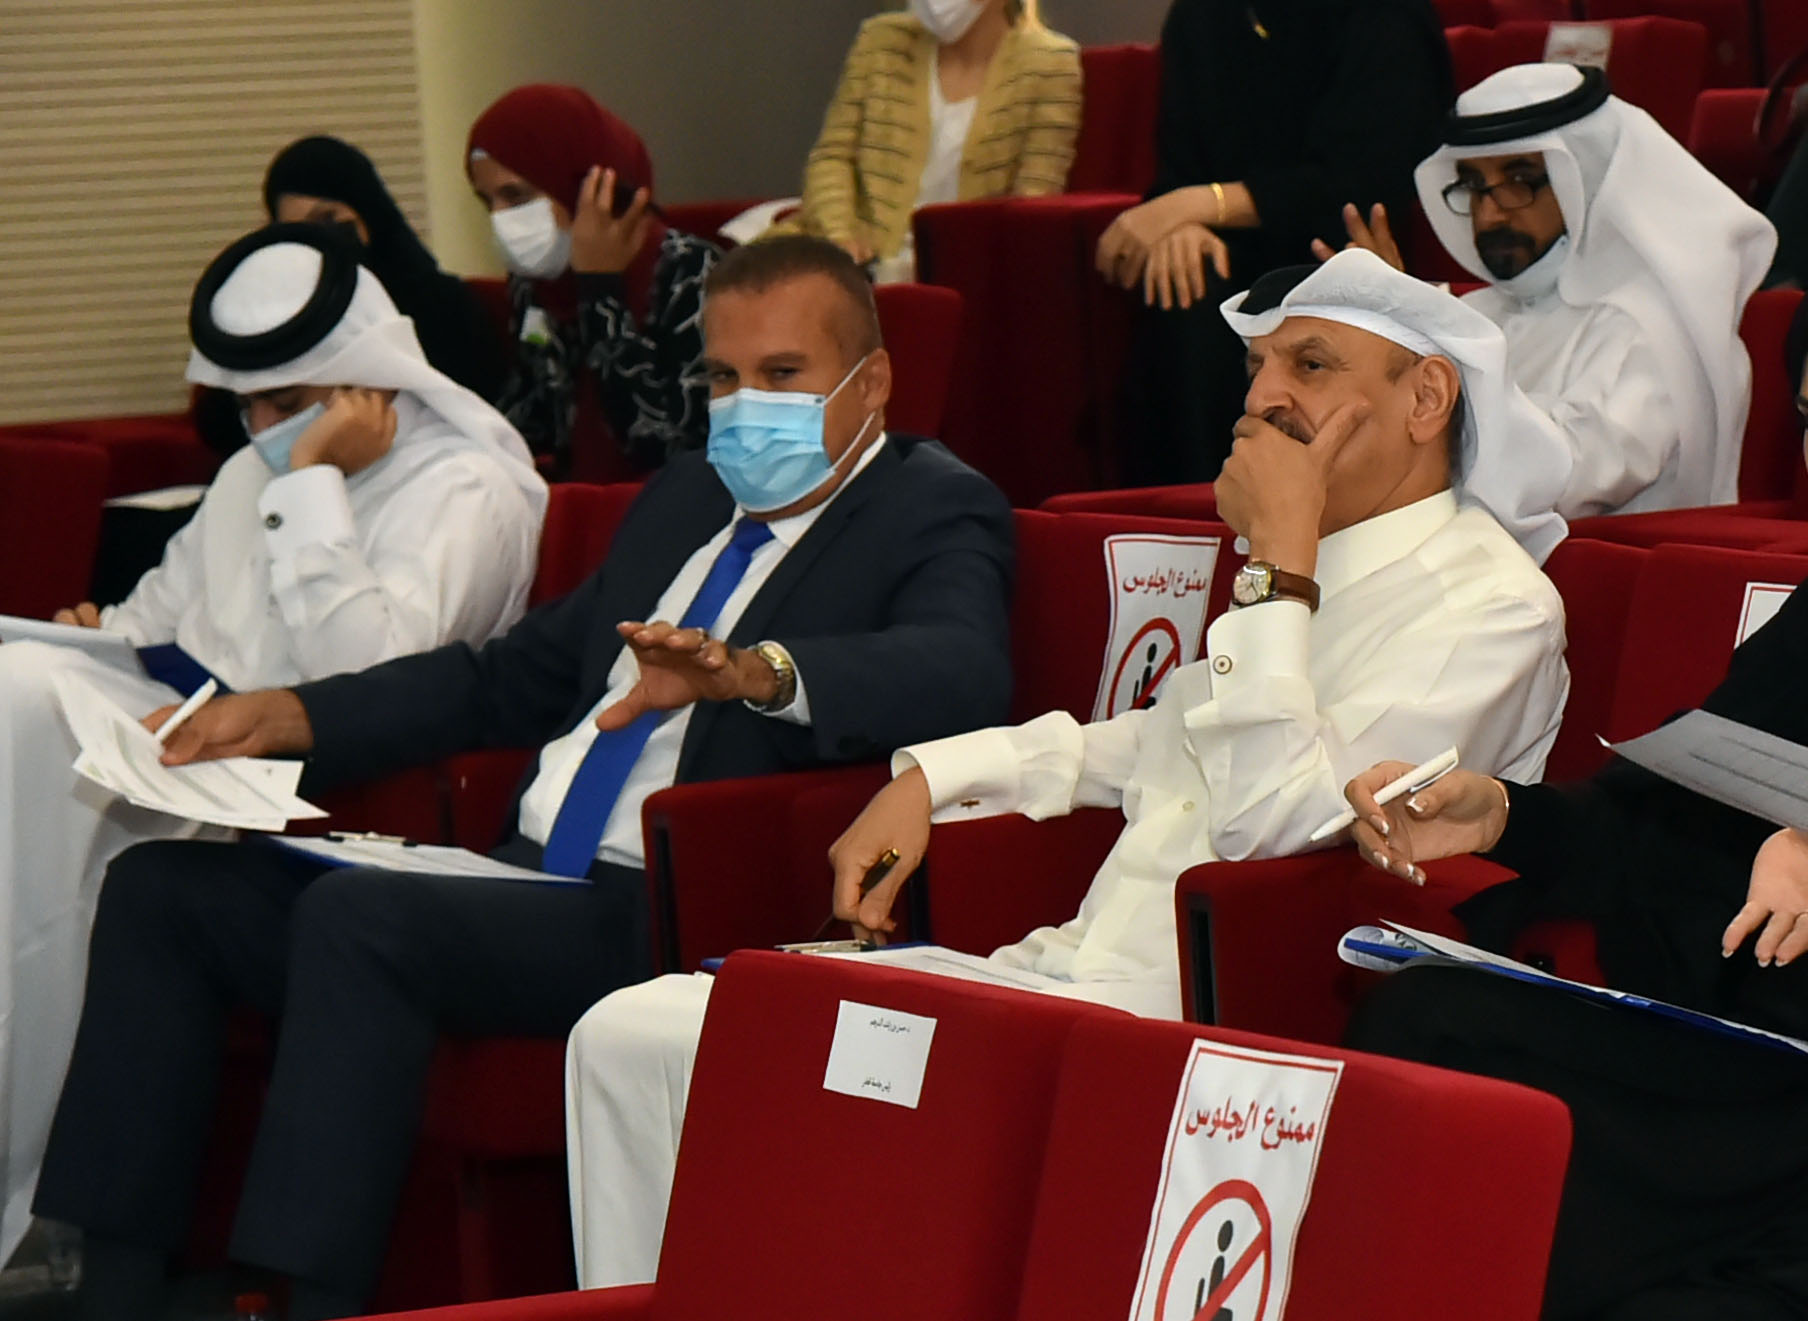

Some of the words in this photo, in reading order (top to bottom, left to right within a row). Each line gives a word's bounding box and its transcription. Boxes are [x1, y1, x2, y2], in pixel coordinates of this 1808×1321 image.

[1122, 565, 1176, 597] الجلوس
[1185, 1096, 1260, 1143] الجلوس
[1260, 1105, 1316, 1150] ممنوع
